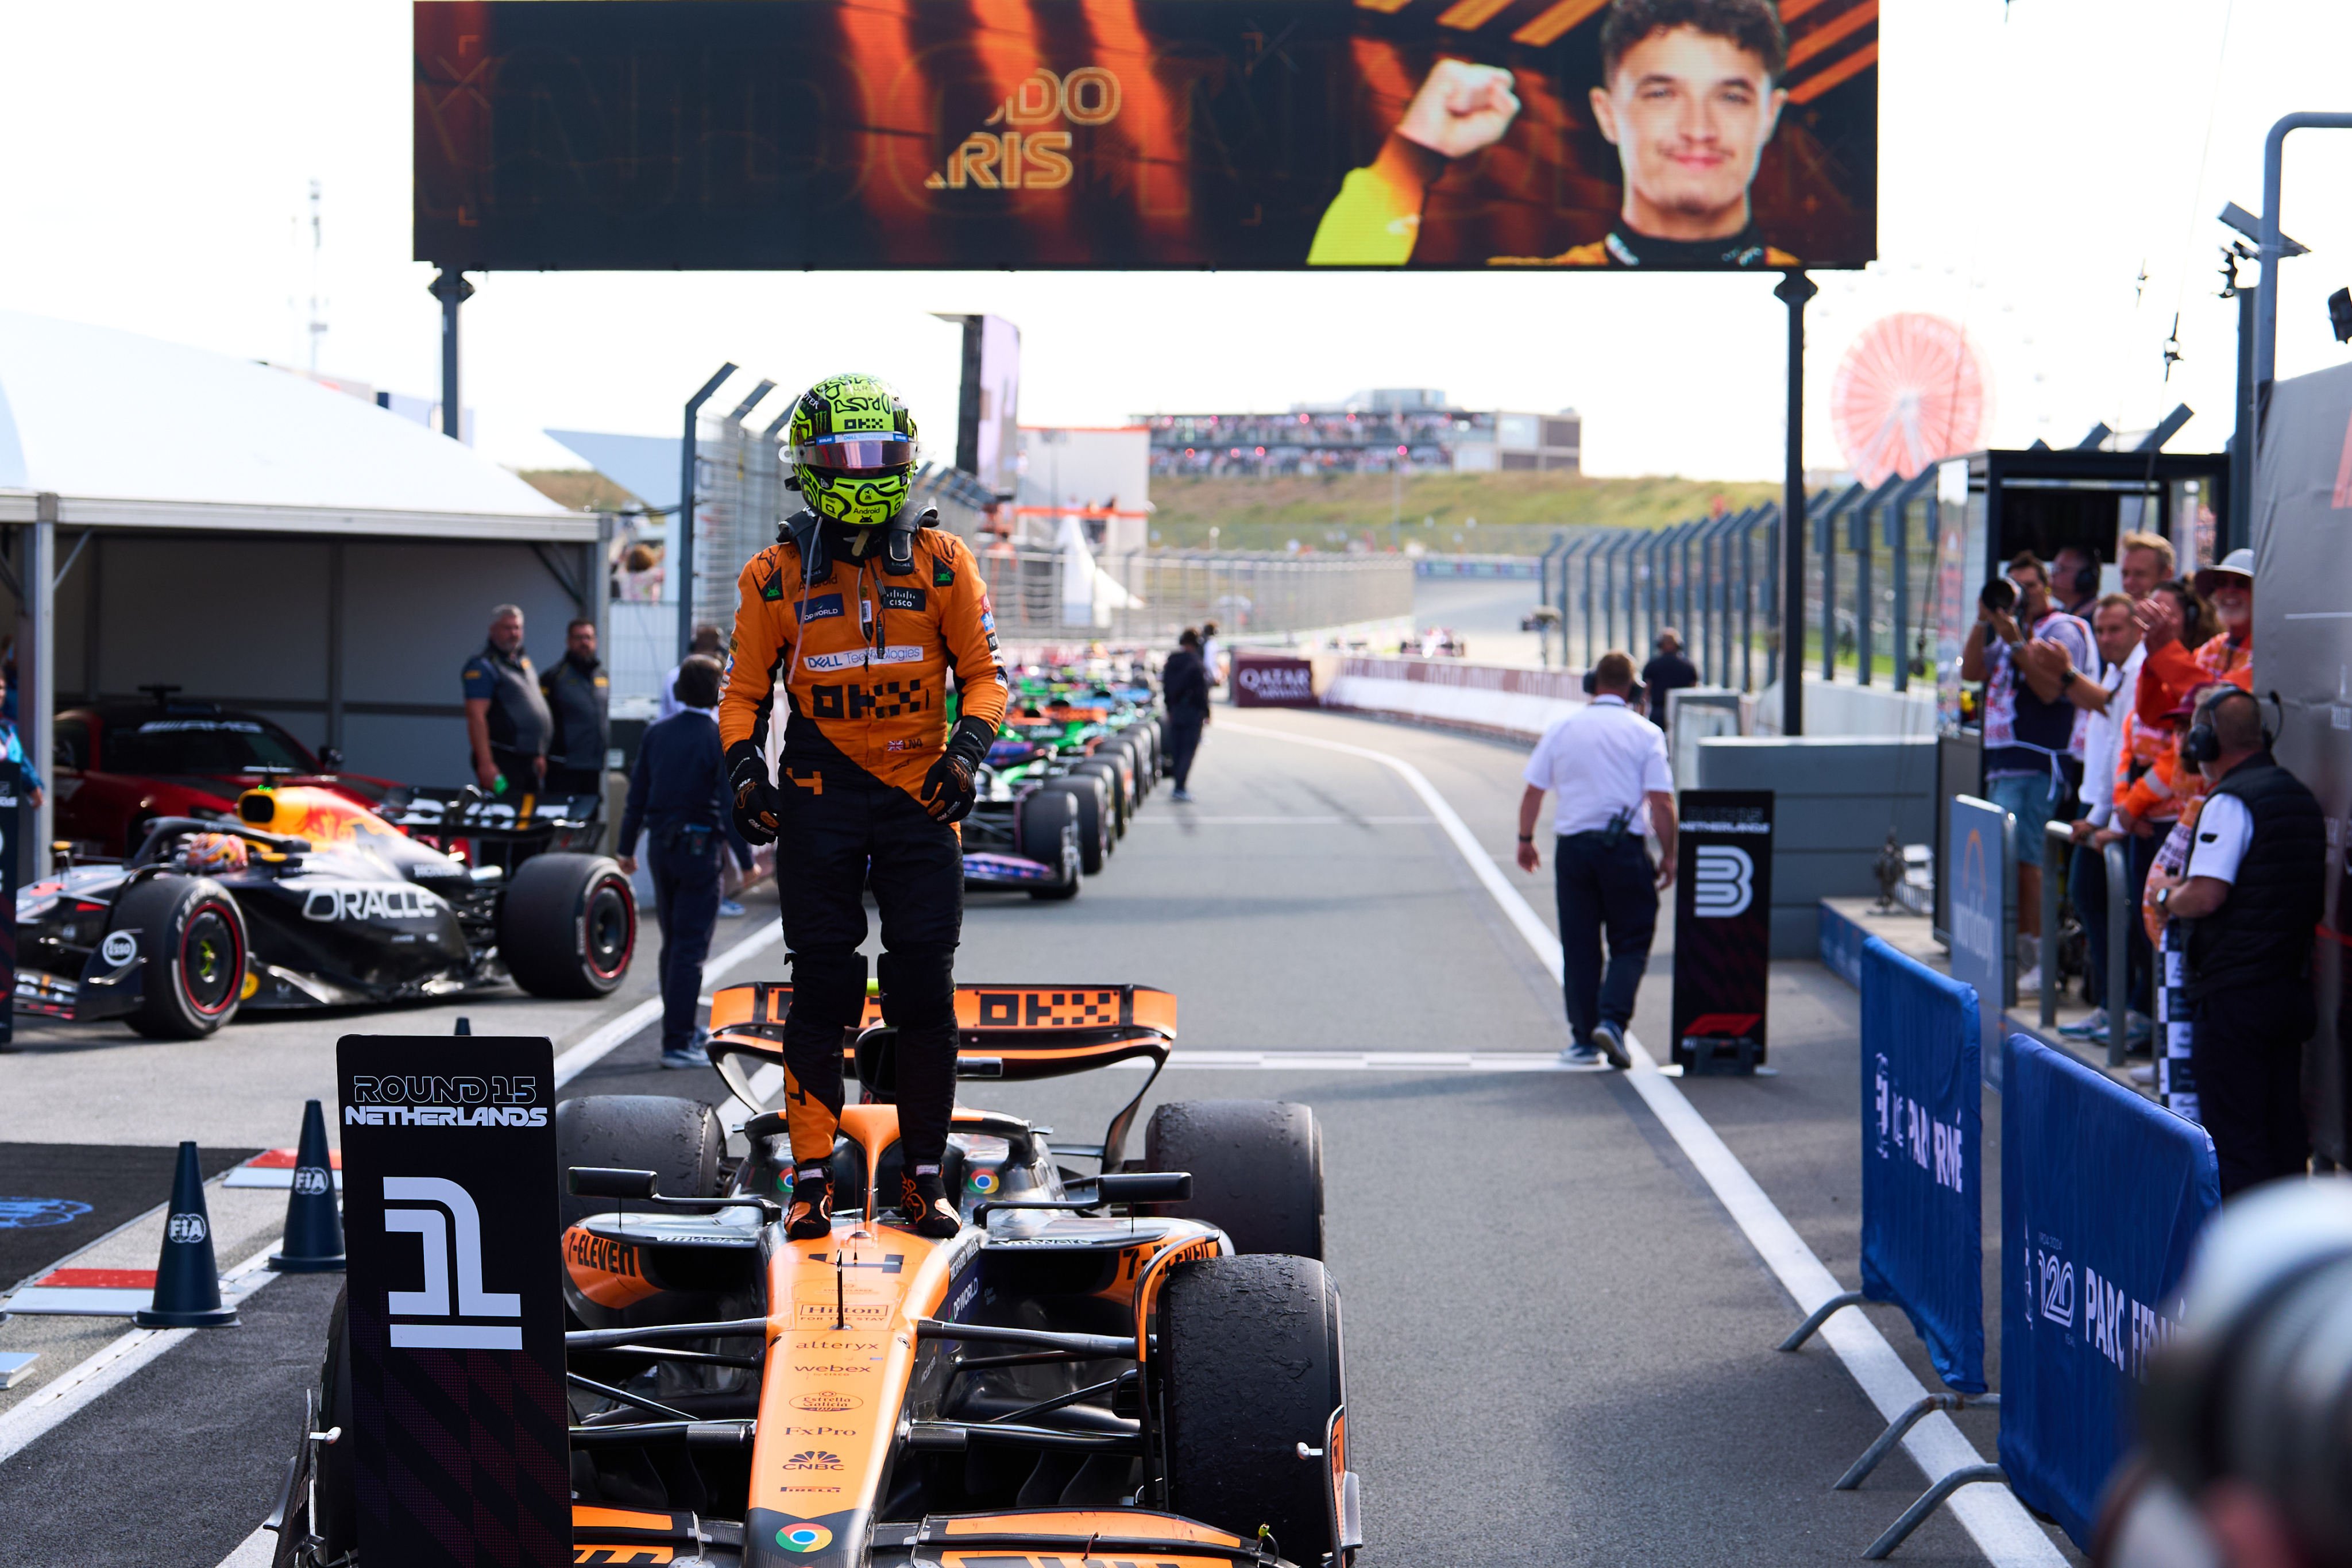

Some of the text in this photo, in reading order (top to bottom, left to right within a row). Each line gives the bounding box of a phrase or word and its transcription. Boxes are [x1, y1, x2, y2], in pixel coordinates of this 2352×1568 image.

[844, 418, 883, 430] OKX
[808, 655, 843, 669] DELL
[1239, 667, 1310, 693] QATAR
[811, 679, 921, 719] OKX
[302, 889, 437, 922] ORACLE
[980, 993, 1110, 1026] OKX
[354, 1076, 536, 1104] ROUND 15
[345, 1106, 547, 1127] NETHERLANDS
[656, 1235, 744, 1245] vmware
[383, 1176, 523, 1350] 1
[960, 1277, 978, 1311] WORLD
[2038, 1248, 2075, 1328] 120
[2086, 1266, 2125, 1372] PARC
[796, 1341, 879, 1351] alteryx
[785, 1427, 856, 1436] FxPro
